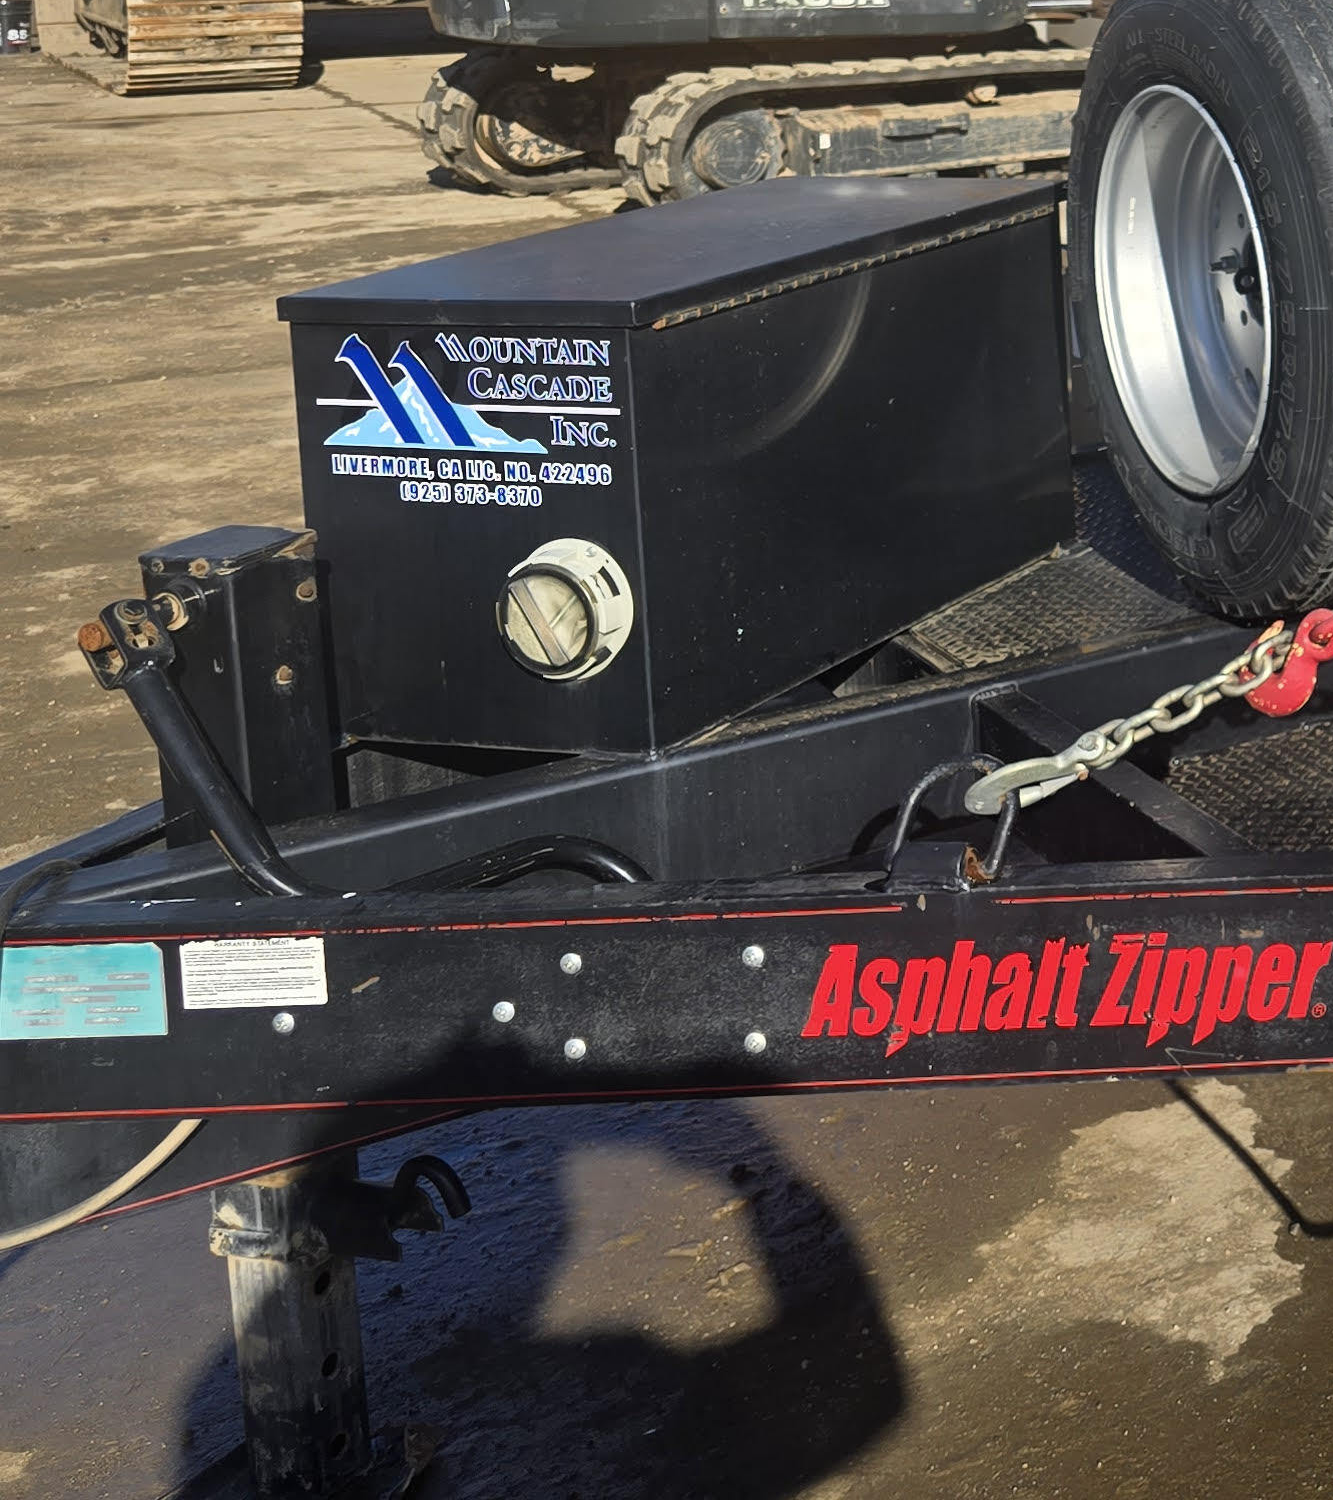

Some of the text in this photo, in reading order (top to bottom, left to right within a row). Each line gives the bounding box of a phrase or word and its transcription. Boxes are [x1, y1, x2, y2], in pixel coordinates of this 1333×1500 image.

[435, 332, 611, 366] MOUNTAIN
[467, 367, 613, 403] CASCADE
[550, 416, 617, 448] INC.
[332, 454, 613, 486] LIVERMORE, CA LIC. NO. 422496
[400, 482, 543, 507] (925) 373-8370
[801, 937, 1089, 1059] Asphalt
